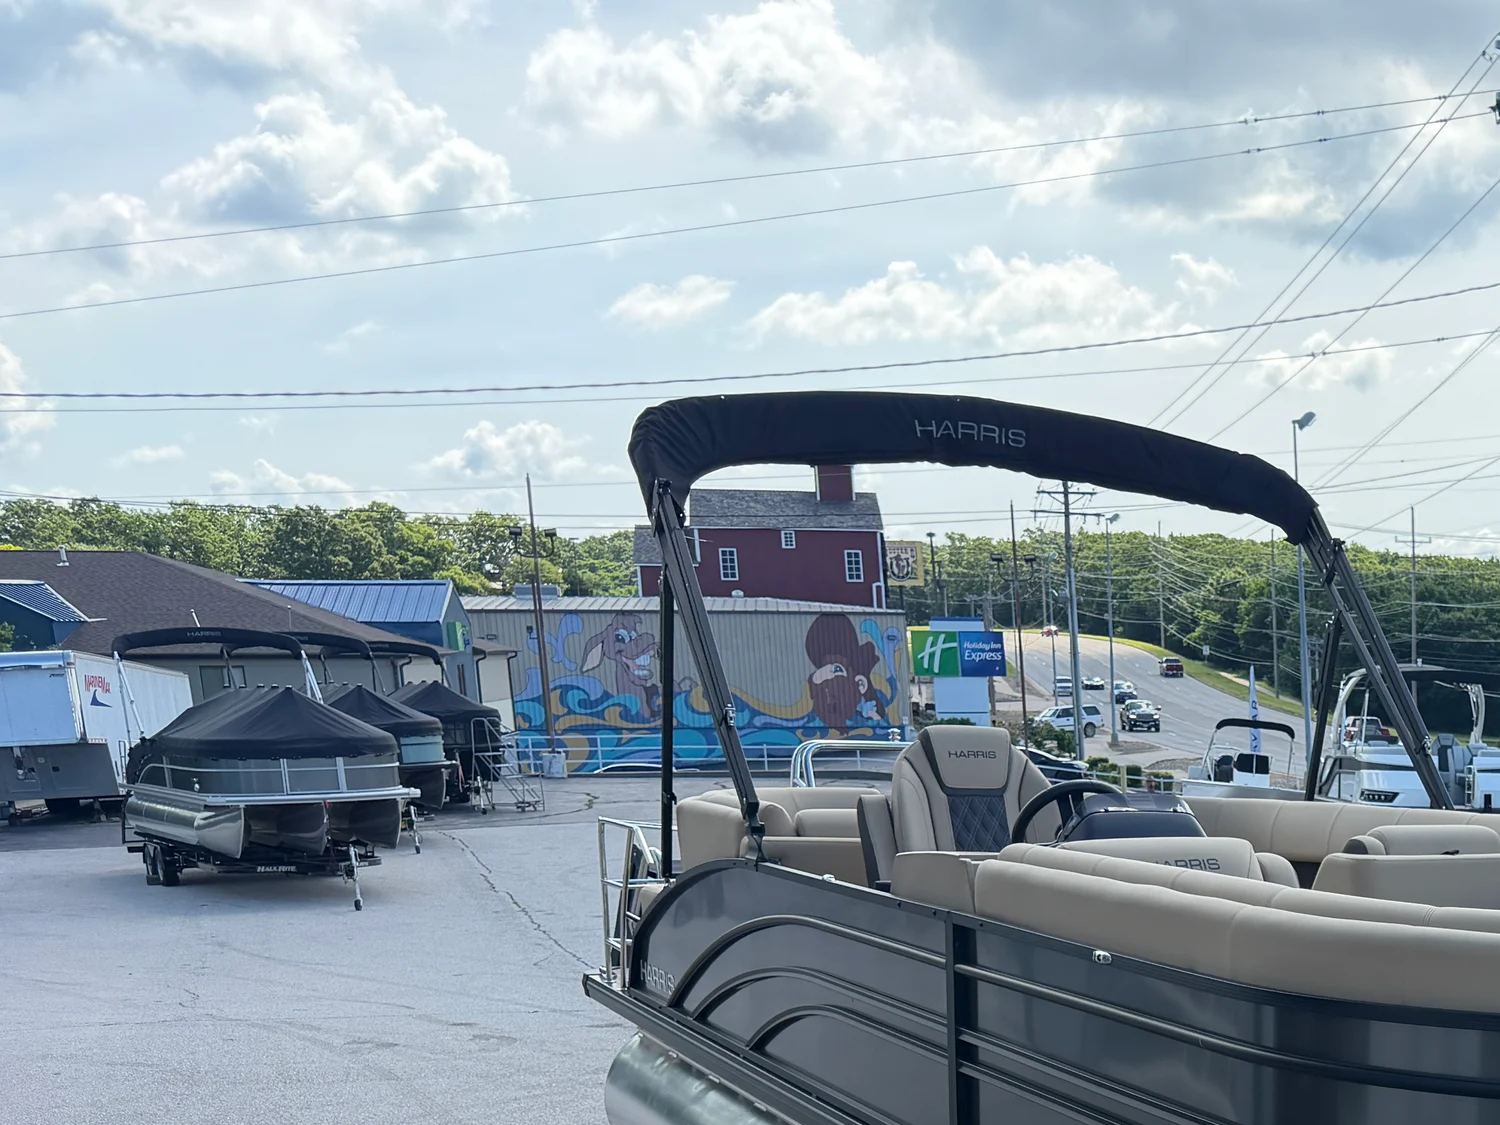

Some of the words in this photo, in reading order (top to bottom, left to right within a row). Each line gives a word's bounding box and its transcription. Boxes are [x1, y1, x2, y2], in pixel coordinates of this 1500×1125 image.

[914, 419, 1027, 448] HARRIS
[963, 640, 990, 651] Holiday
[990, 641, 1002, 649] Inn
[964, 650, 1003, 663] Express
[947, 750, 997, 759] HARRIS
